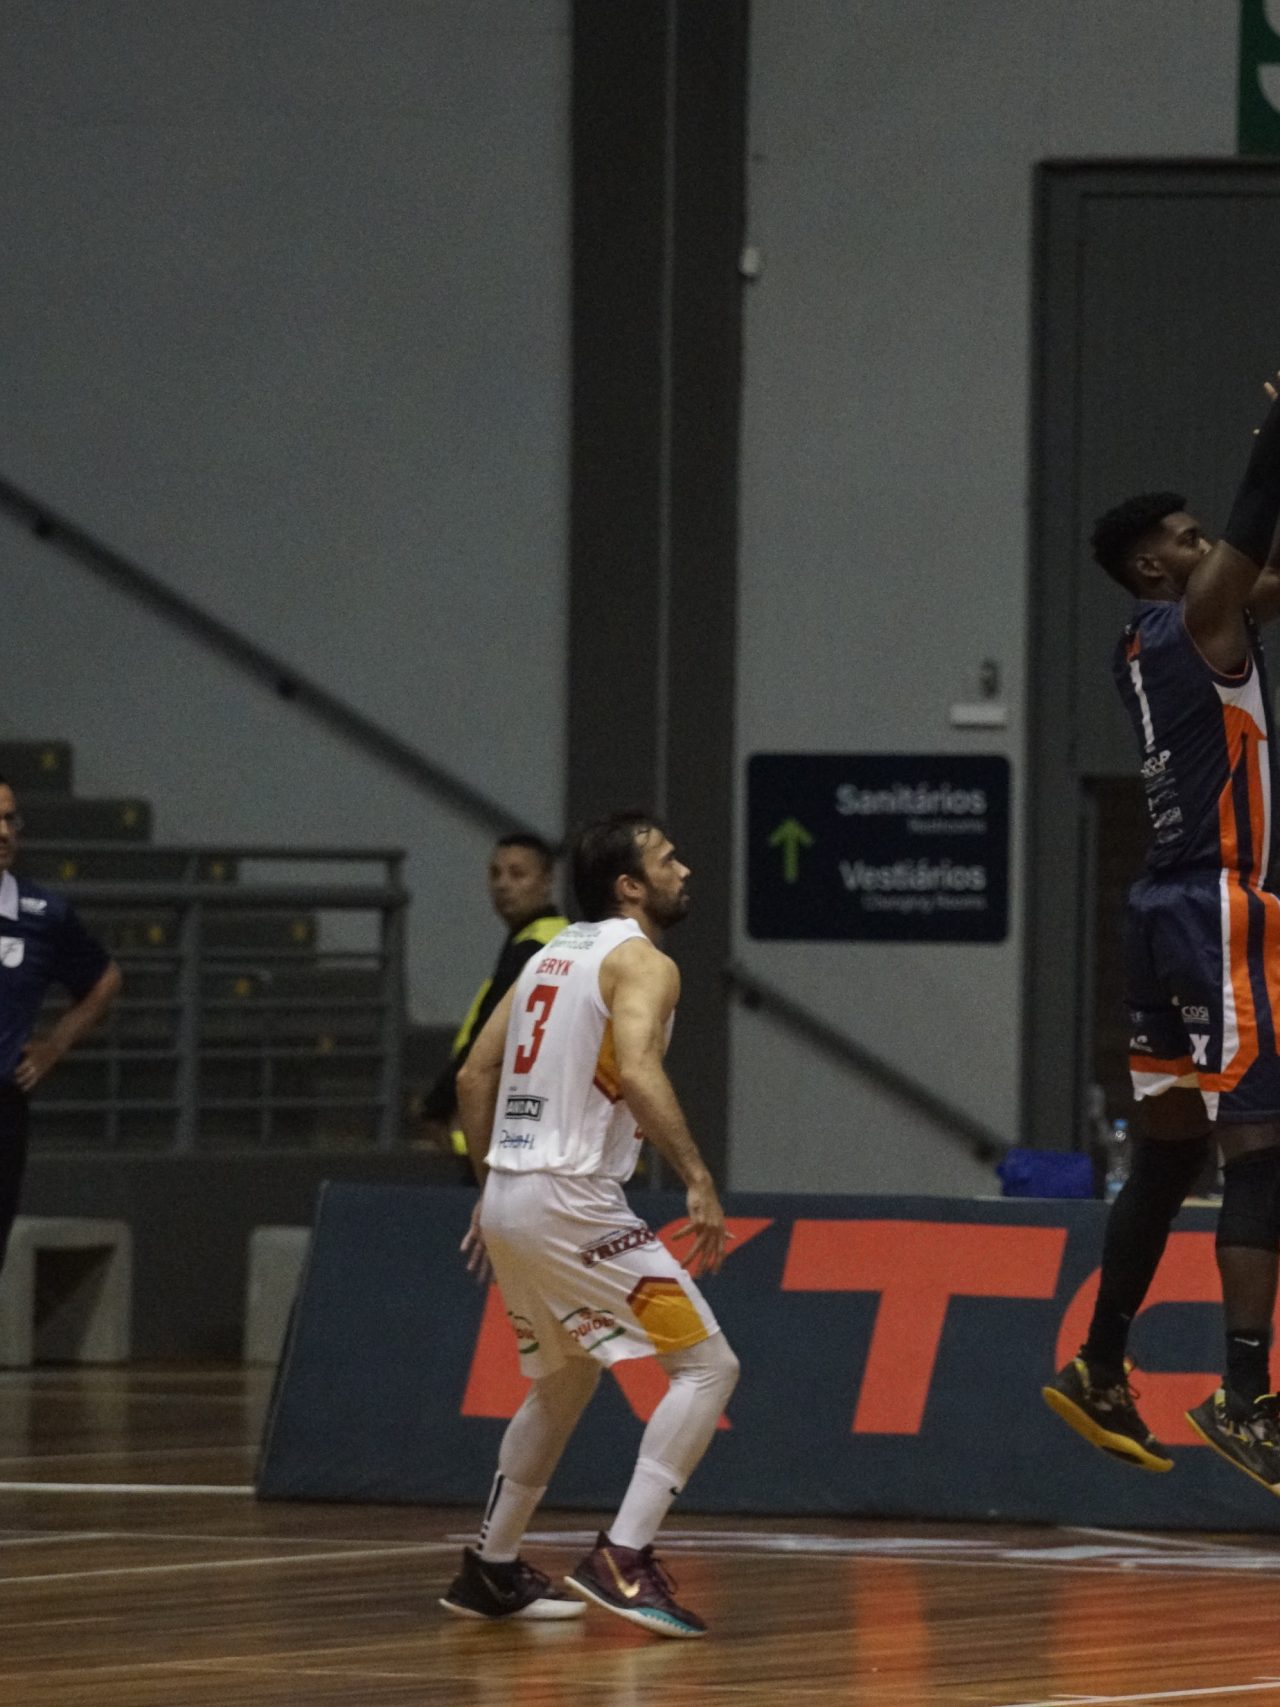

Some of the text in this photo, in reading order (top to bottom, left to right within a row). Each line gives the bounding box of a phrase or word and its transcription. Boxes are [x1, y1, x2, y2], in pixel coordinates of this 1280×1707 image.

[836, 782, 988, 816] Sanitários
[838, 858, 988, 892] Vestiários
[513, 984, 559, 1075] 3
